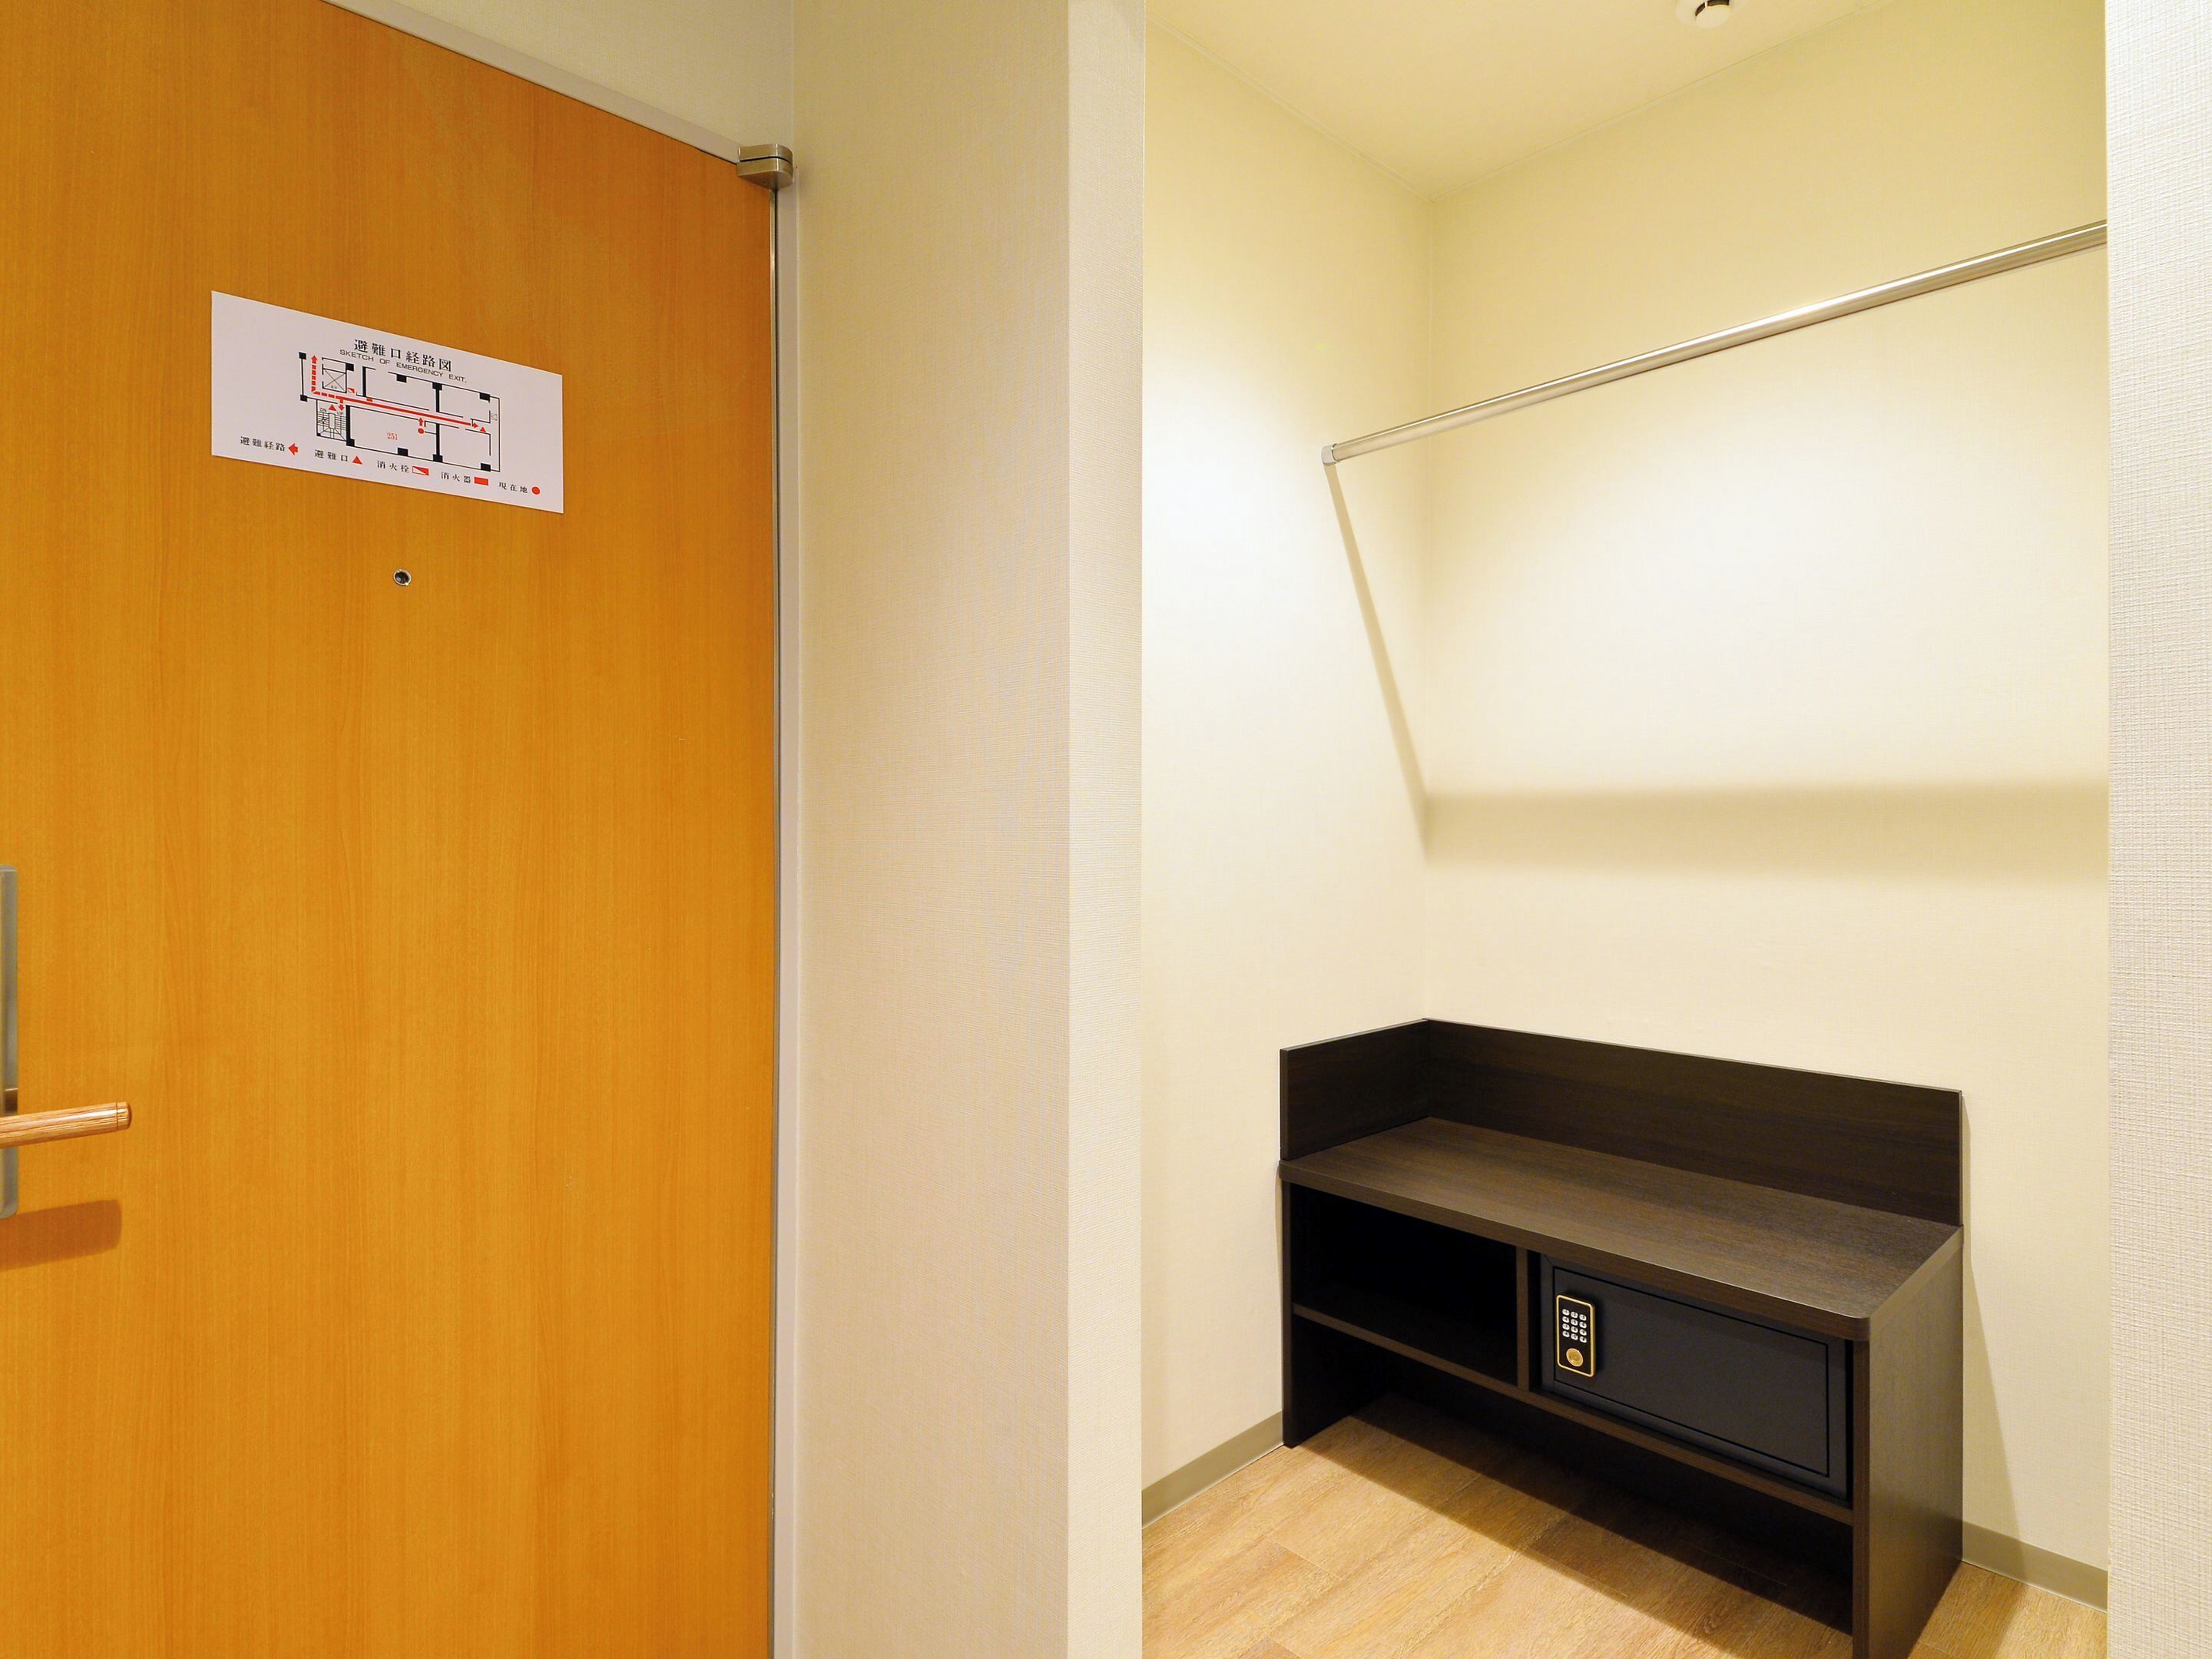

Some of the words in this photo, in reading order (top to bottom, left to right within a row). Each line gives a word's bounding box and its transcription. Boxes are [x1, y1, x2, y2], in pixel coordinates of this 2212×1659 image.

[354, 339, 452, 372] 避難口経路図
[339, 349, 374, 362] SKETCH
[396, 362, 443, 377] EMERGENCY
[386, 432, 398, 440] 251
[240, 435, 286, 452] 避難経路
[314, 449, 348, 462] 避難口
[376, 460, 409, 473] 消火栓
[440, 471, 472, 484] 消火器
[498, 482, 528, 494] 現在地
